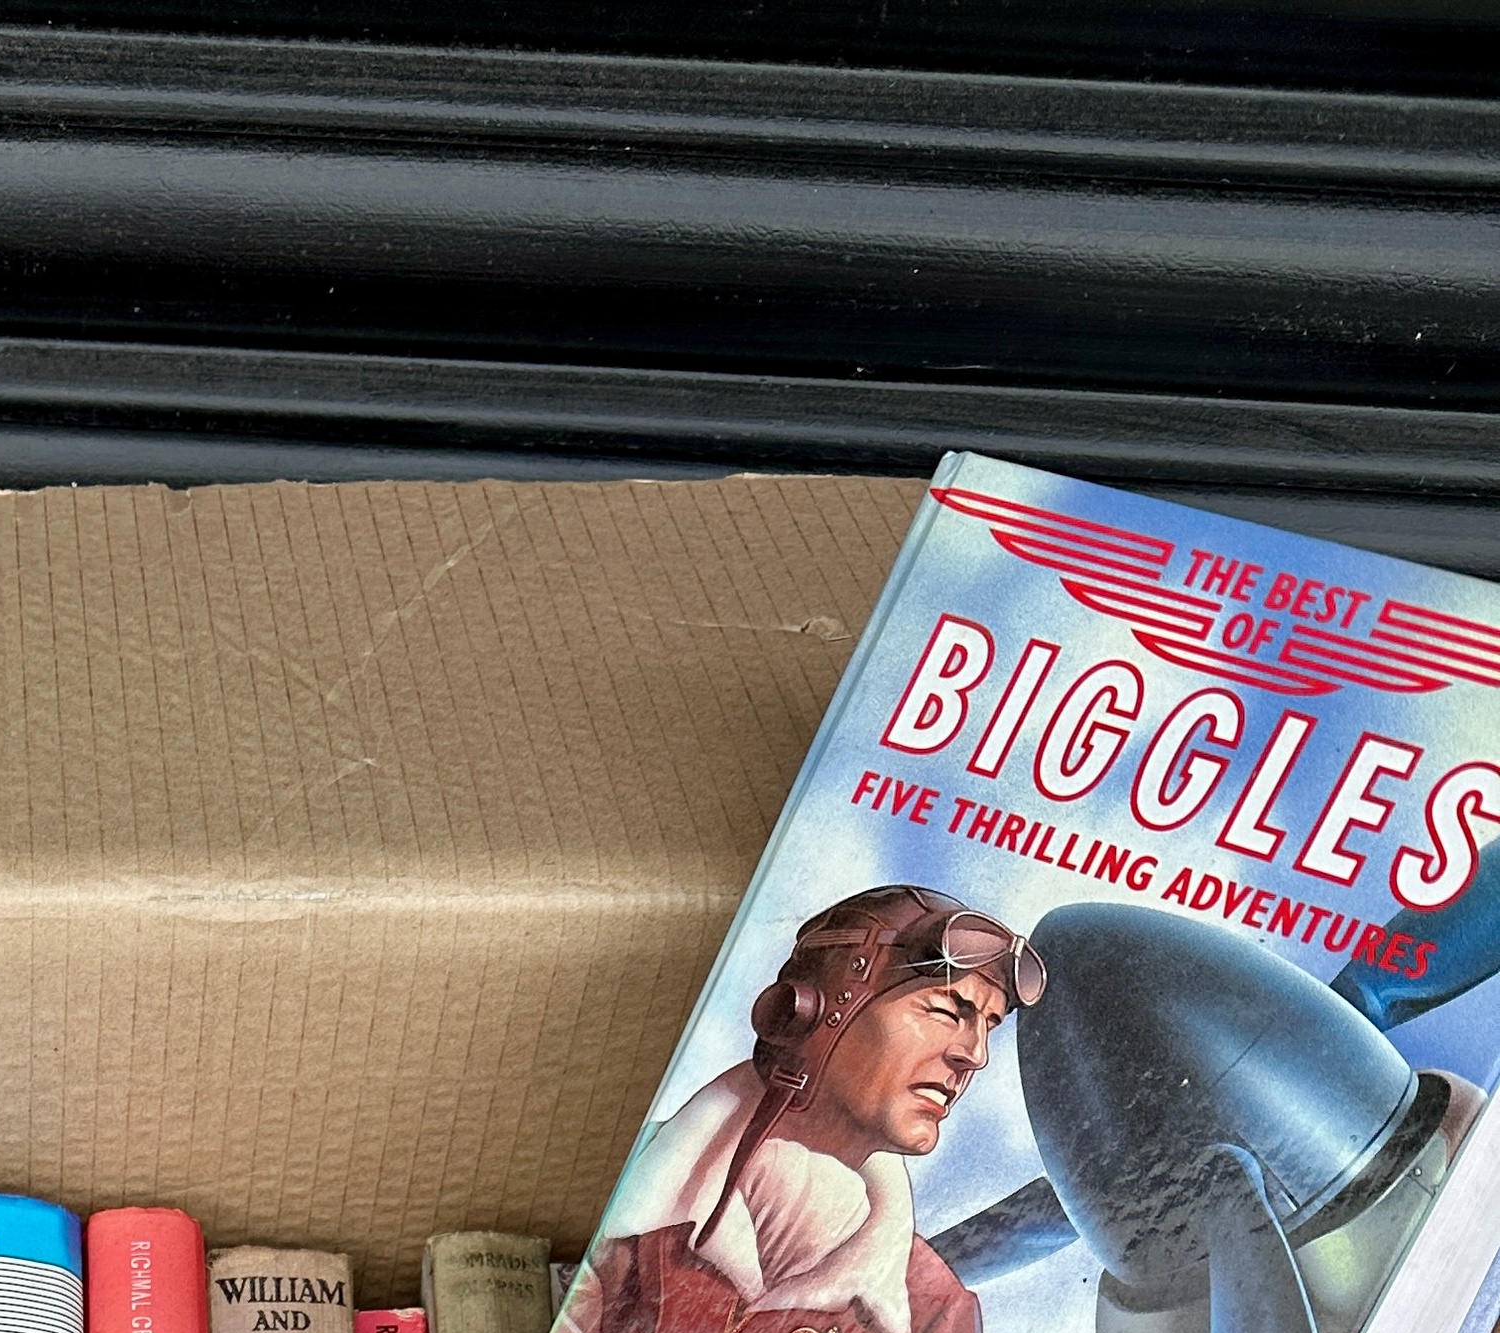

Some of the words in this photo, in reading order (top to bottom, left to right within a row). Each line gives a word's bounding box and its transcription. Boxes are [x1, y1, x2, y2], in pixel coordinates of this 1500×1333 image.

[1181, 549, 1264, 602] THE
[1264, 572, 1372, 629] BEST
[1221, 612, 1283, 653] OF
[881, 613, 1500, 911] BIGGLES
[852, 771, 939, 824] FIVE
[949, 798, 1158, 891] THRILLING
[1162, 868, 1437, 980] ADVENTURES
[130, 1241, 152, 1311] RICHMAL
[215, 1277, 346, 1307] WILLIAM
[252, 1310, 311, 1332] AND
